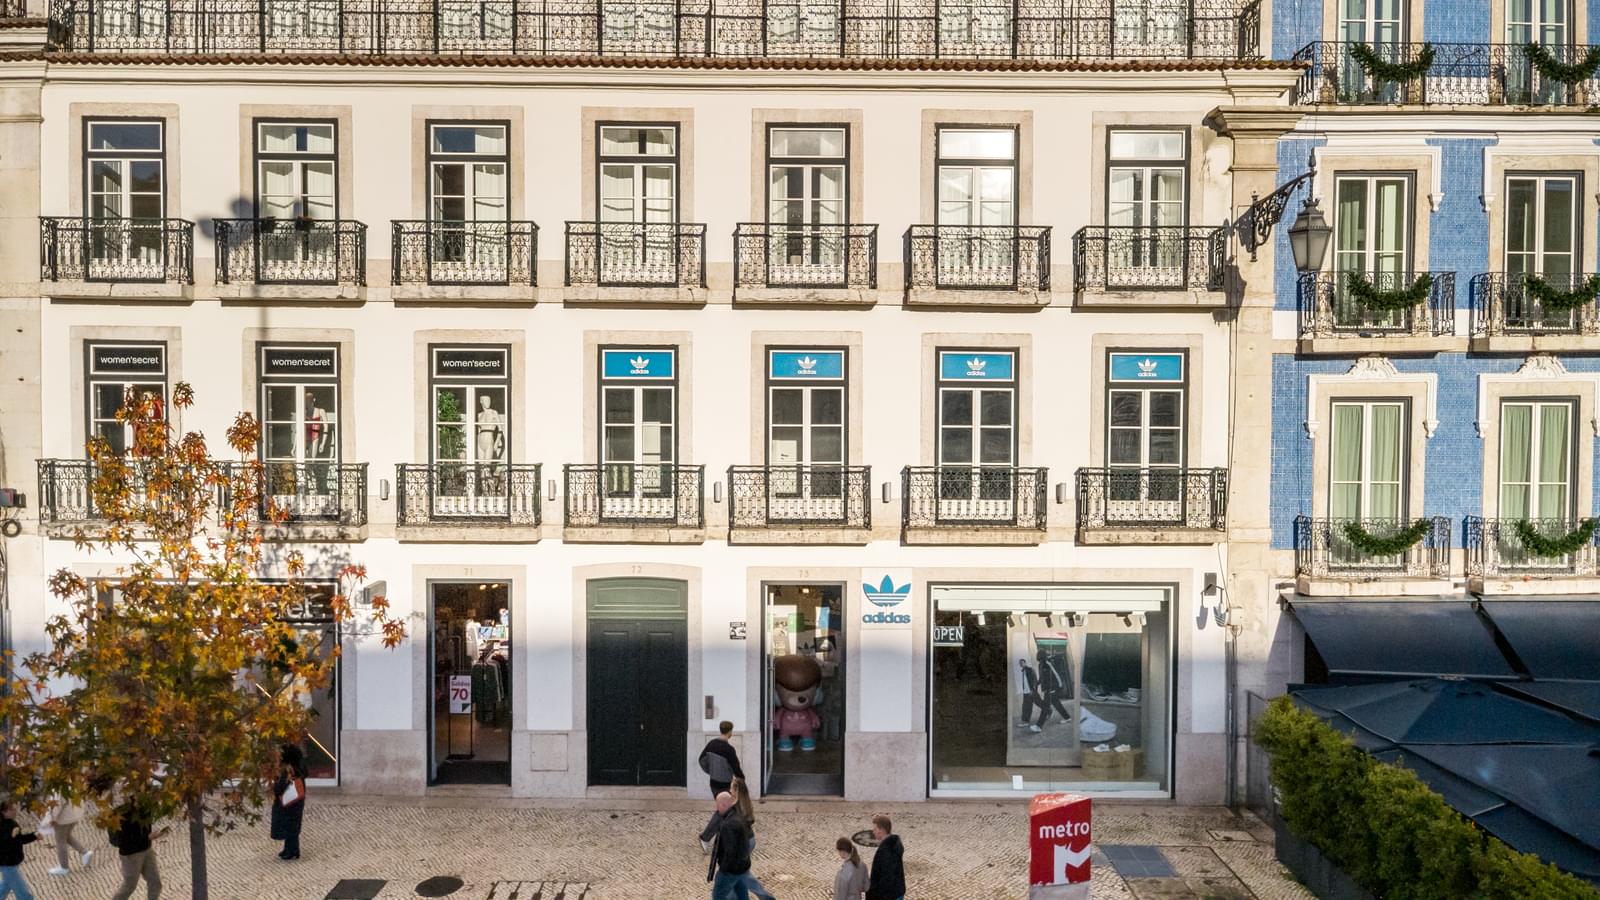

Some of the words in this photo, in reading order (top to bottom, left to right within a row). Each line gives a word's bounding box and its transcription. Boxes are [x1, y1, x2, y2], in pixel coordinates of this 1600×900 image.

[100, 356, 159, 364] women'secret
[271, 358, 331, 366] women'secret
[442, 360, 501, 368] women'secret
[862, 612, 911, 624] adidas
[933, 627, 965, 641] OPEN
[451, 688, 468, 700] 70
[1039, 820, 1090, 839] metro
